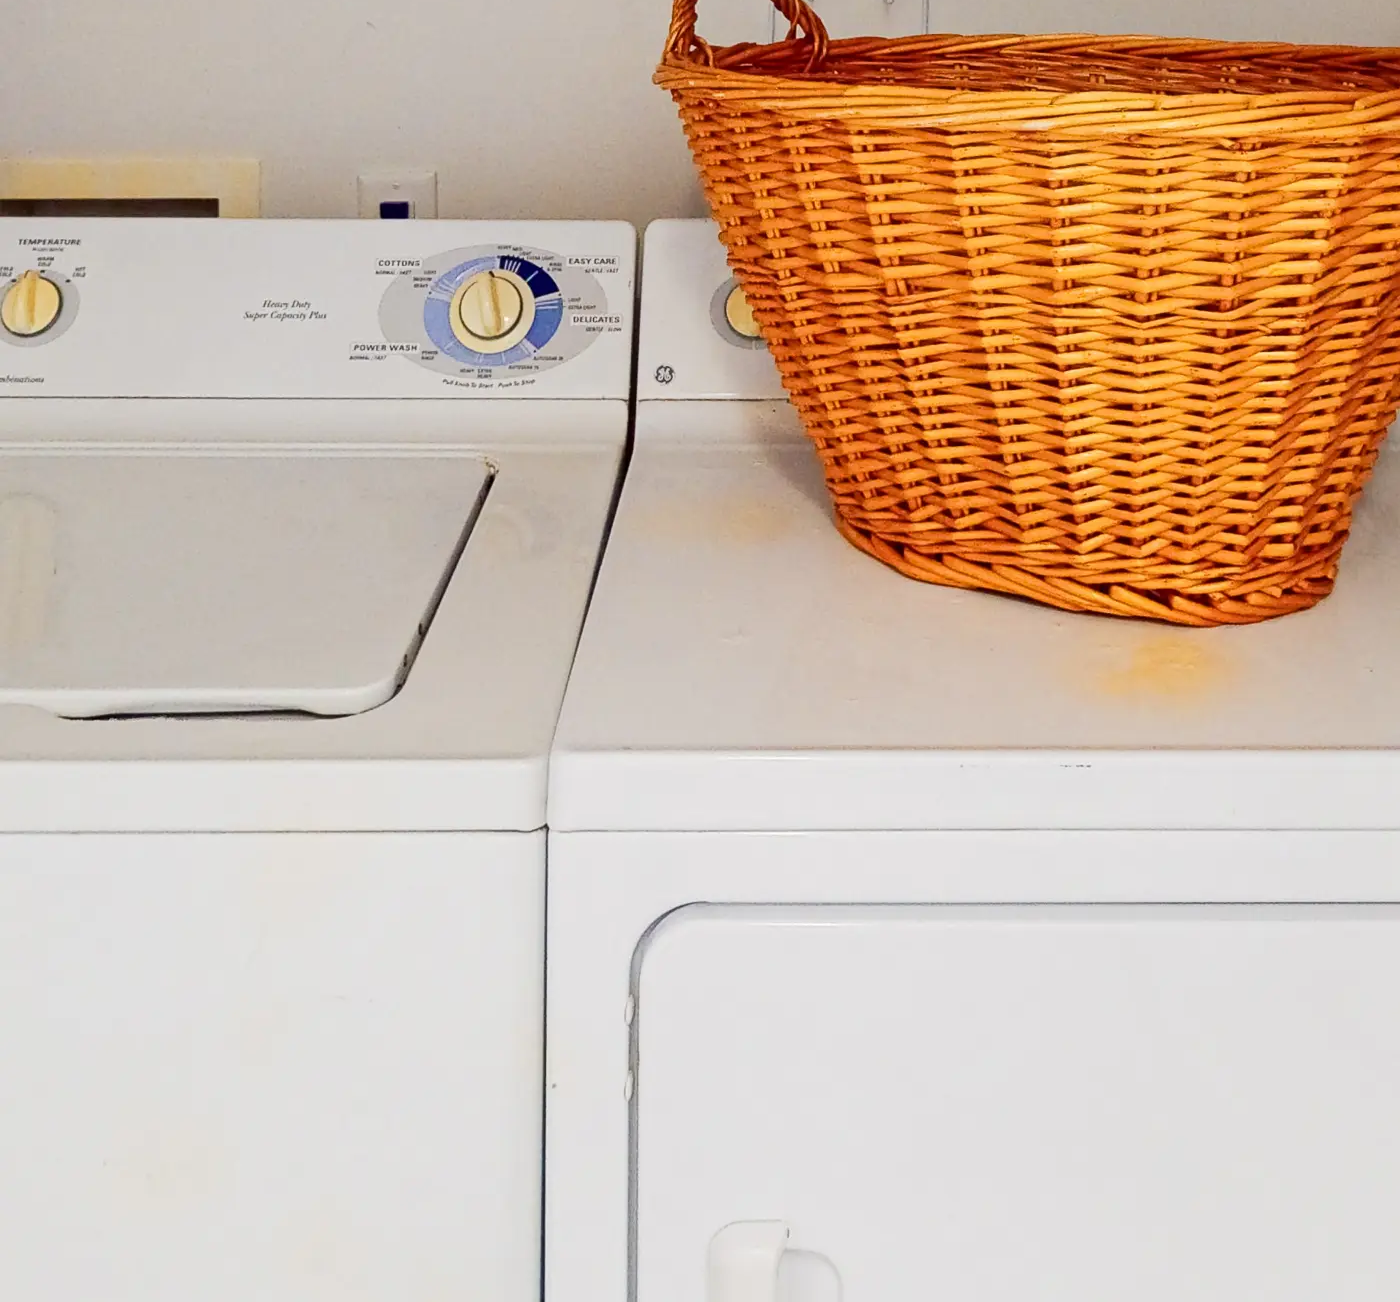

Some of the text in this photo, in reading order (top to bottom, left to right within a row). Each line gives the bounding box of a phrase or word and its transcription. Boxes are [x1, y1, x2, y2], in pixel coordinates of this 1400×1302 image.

[18, 238, 81, 246] TEMPERATURE
[378, 259, 420, 267] COTTONS
[262, 299, 311, 310] Heavy Duty
[243, 311, 327, 322] Super Capacity Plus
